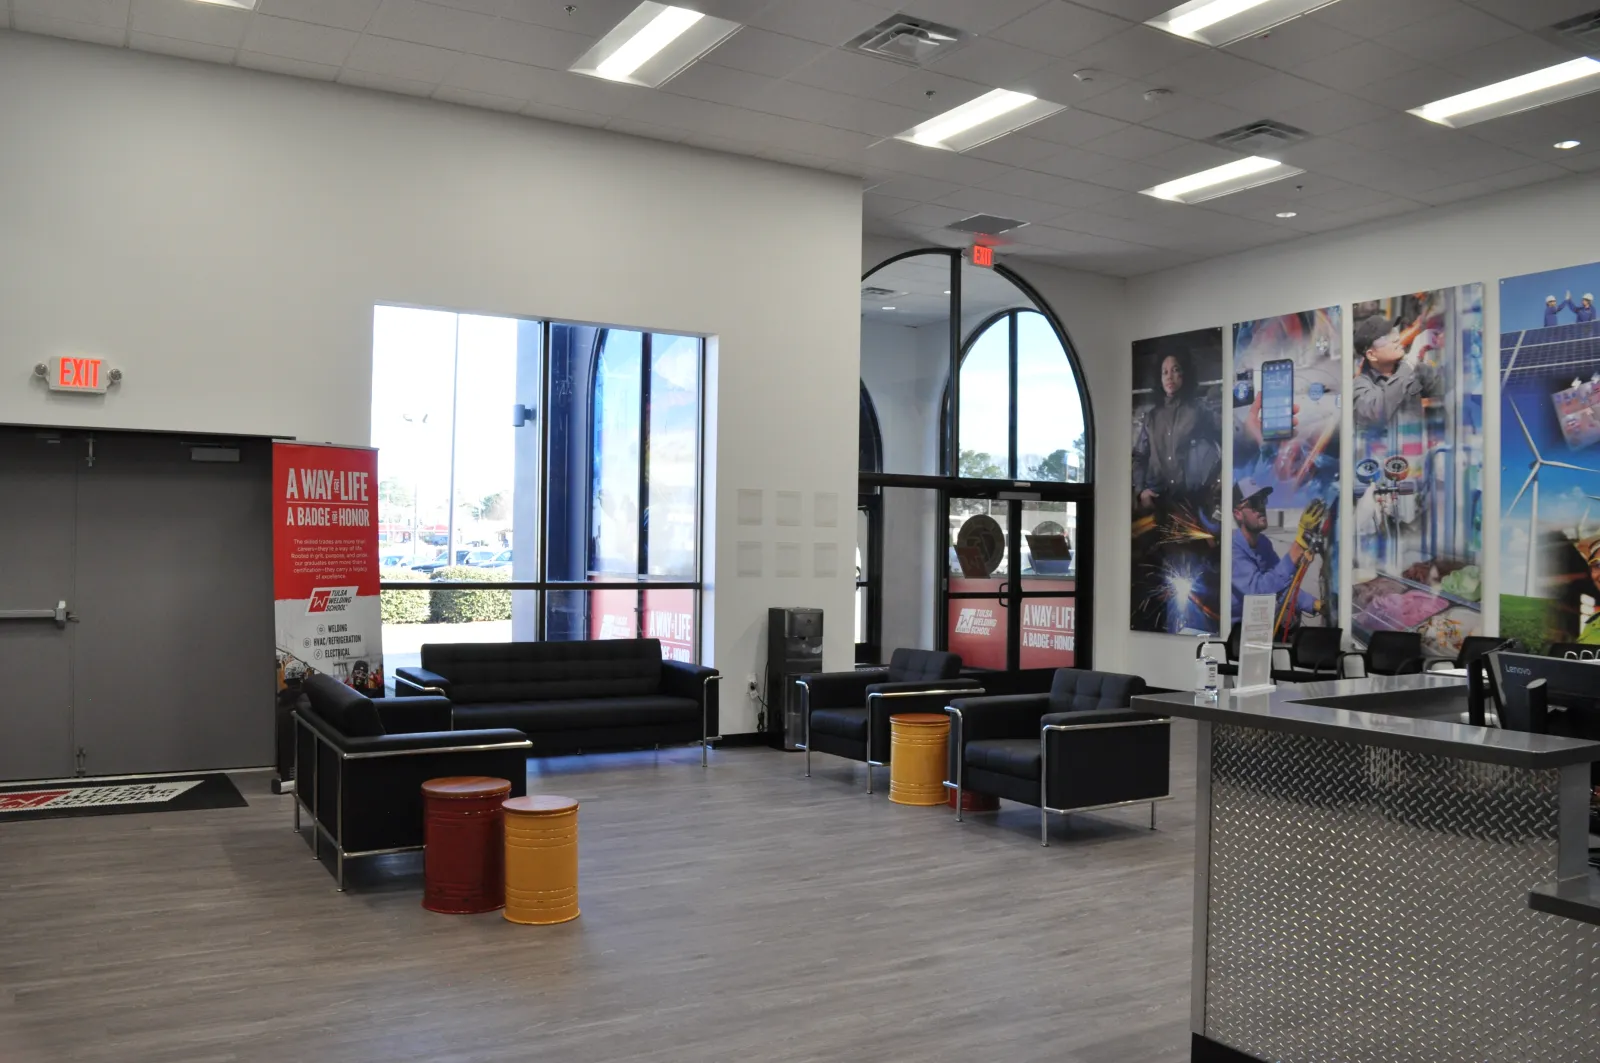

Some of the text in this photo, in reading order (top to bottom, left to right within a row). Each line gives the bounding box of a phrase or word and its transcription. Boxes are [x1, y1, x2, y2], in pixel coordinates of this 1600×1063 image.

[973, 245, 993, 266] EXIT
[59, 357, 102, 388] EXIT
[286, 468, 299, 499] A
[300, 468, 334, 500] WAY
[340, 471, 369, 501] LIFE
[286, 507, 295, 526] A
[297, 507, 331, 526] BADGE
[339, 508, 370, 527] HONOR
[331, 589, 348, 597] TULSA
[328, 596, 352, 604] WELDING
[325, 604, 346, 612] SCHOOL
[973, 617, 998, 628] WELDING
[1023, 604, 1030, 626] A
[1031, 605, 1052, 628] WAY
[327, 624, 348, 633] WELDING
[656, 611, 672, 638] WAY
[674, 613, 691, 641] LIFE
[313, 634, 362, 647] HVAC/REFRIGERATION
[1022, 631, 1028, 647] A
[1028, 632, 1050, 649] BADGE
[324, 648, 351, 658] ELECTRICAL
[1504, 663, 1532, 676] Lenovo
[78, 785, 157, 795] TULSA
